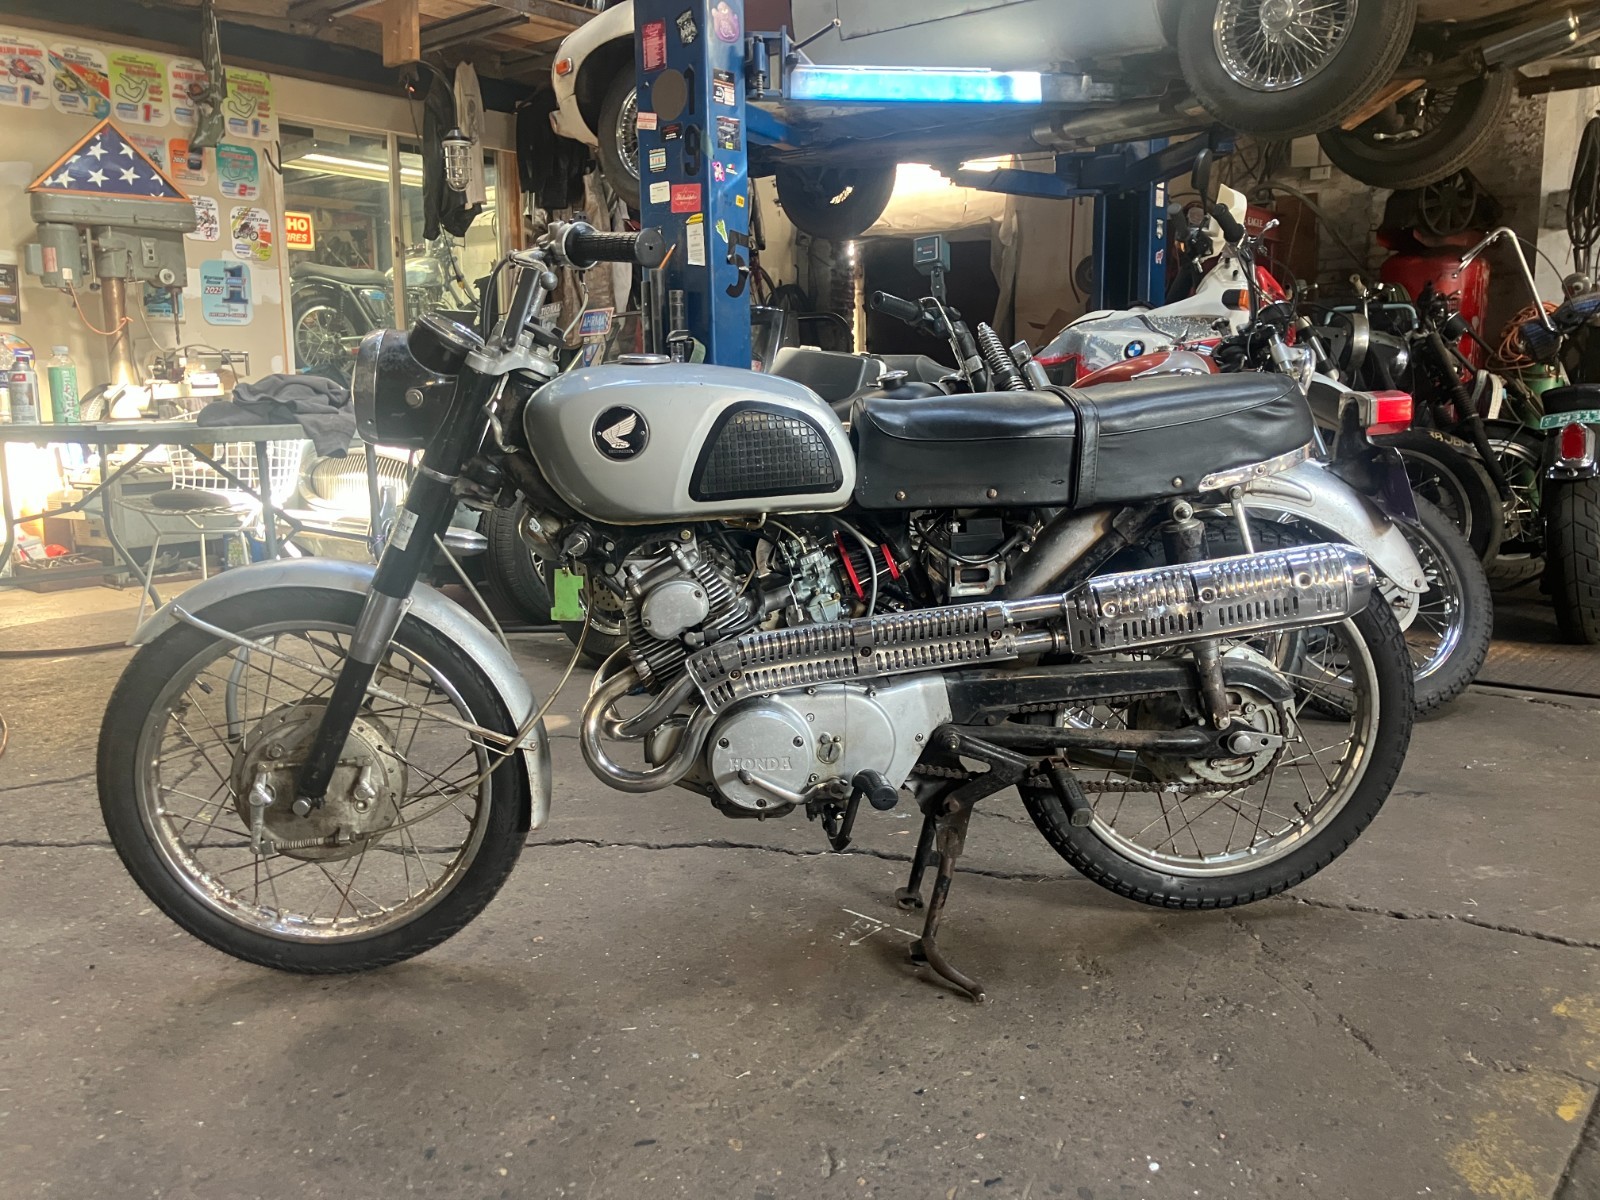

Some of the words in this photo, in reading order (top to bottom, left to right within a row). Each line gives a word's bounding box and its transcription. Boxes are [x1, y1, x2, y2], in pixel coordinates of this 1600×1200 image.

[684, 123, 701, 176] 9
[287, 217, 308, 232] HO
[287, 233, 308, 242] IRES
[726, 229, 750, 298] 5
[204, 286, 224, 295] 2025
[541, 302, 561, 317] TIONAL
[729, 756, 793, 771] HONDA
